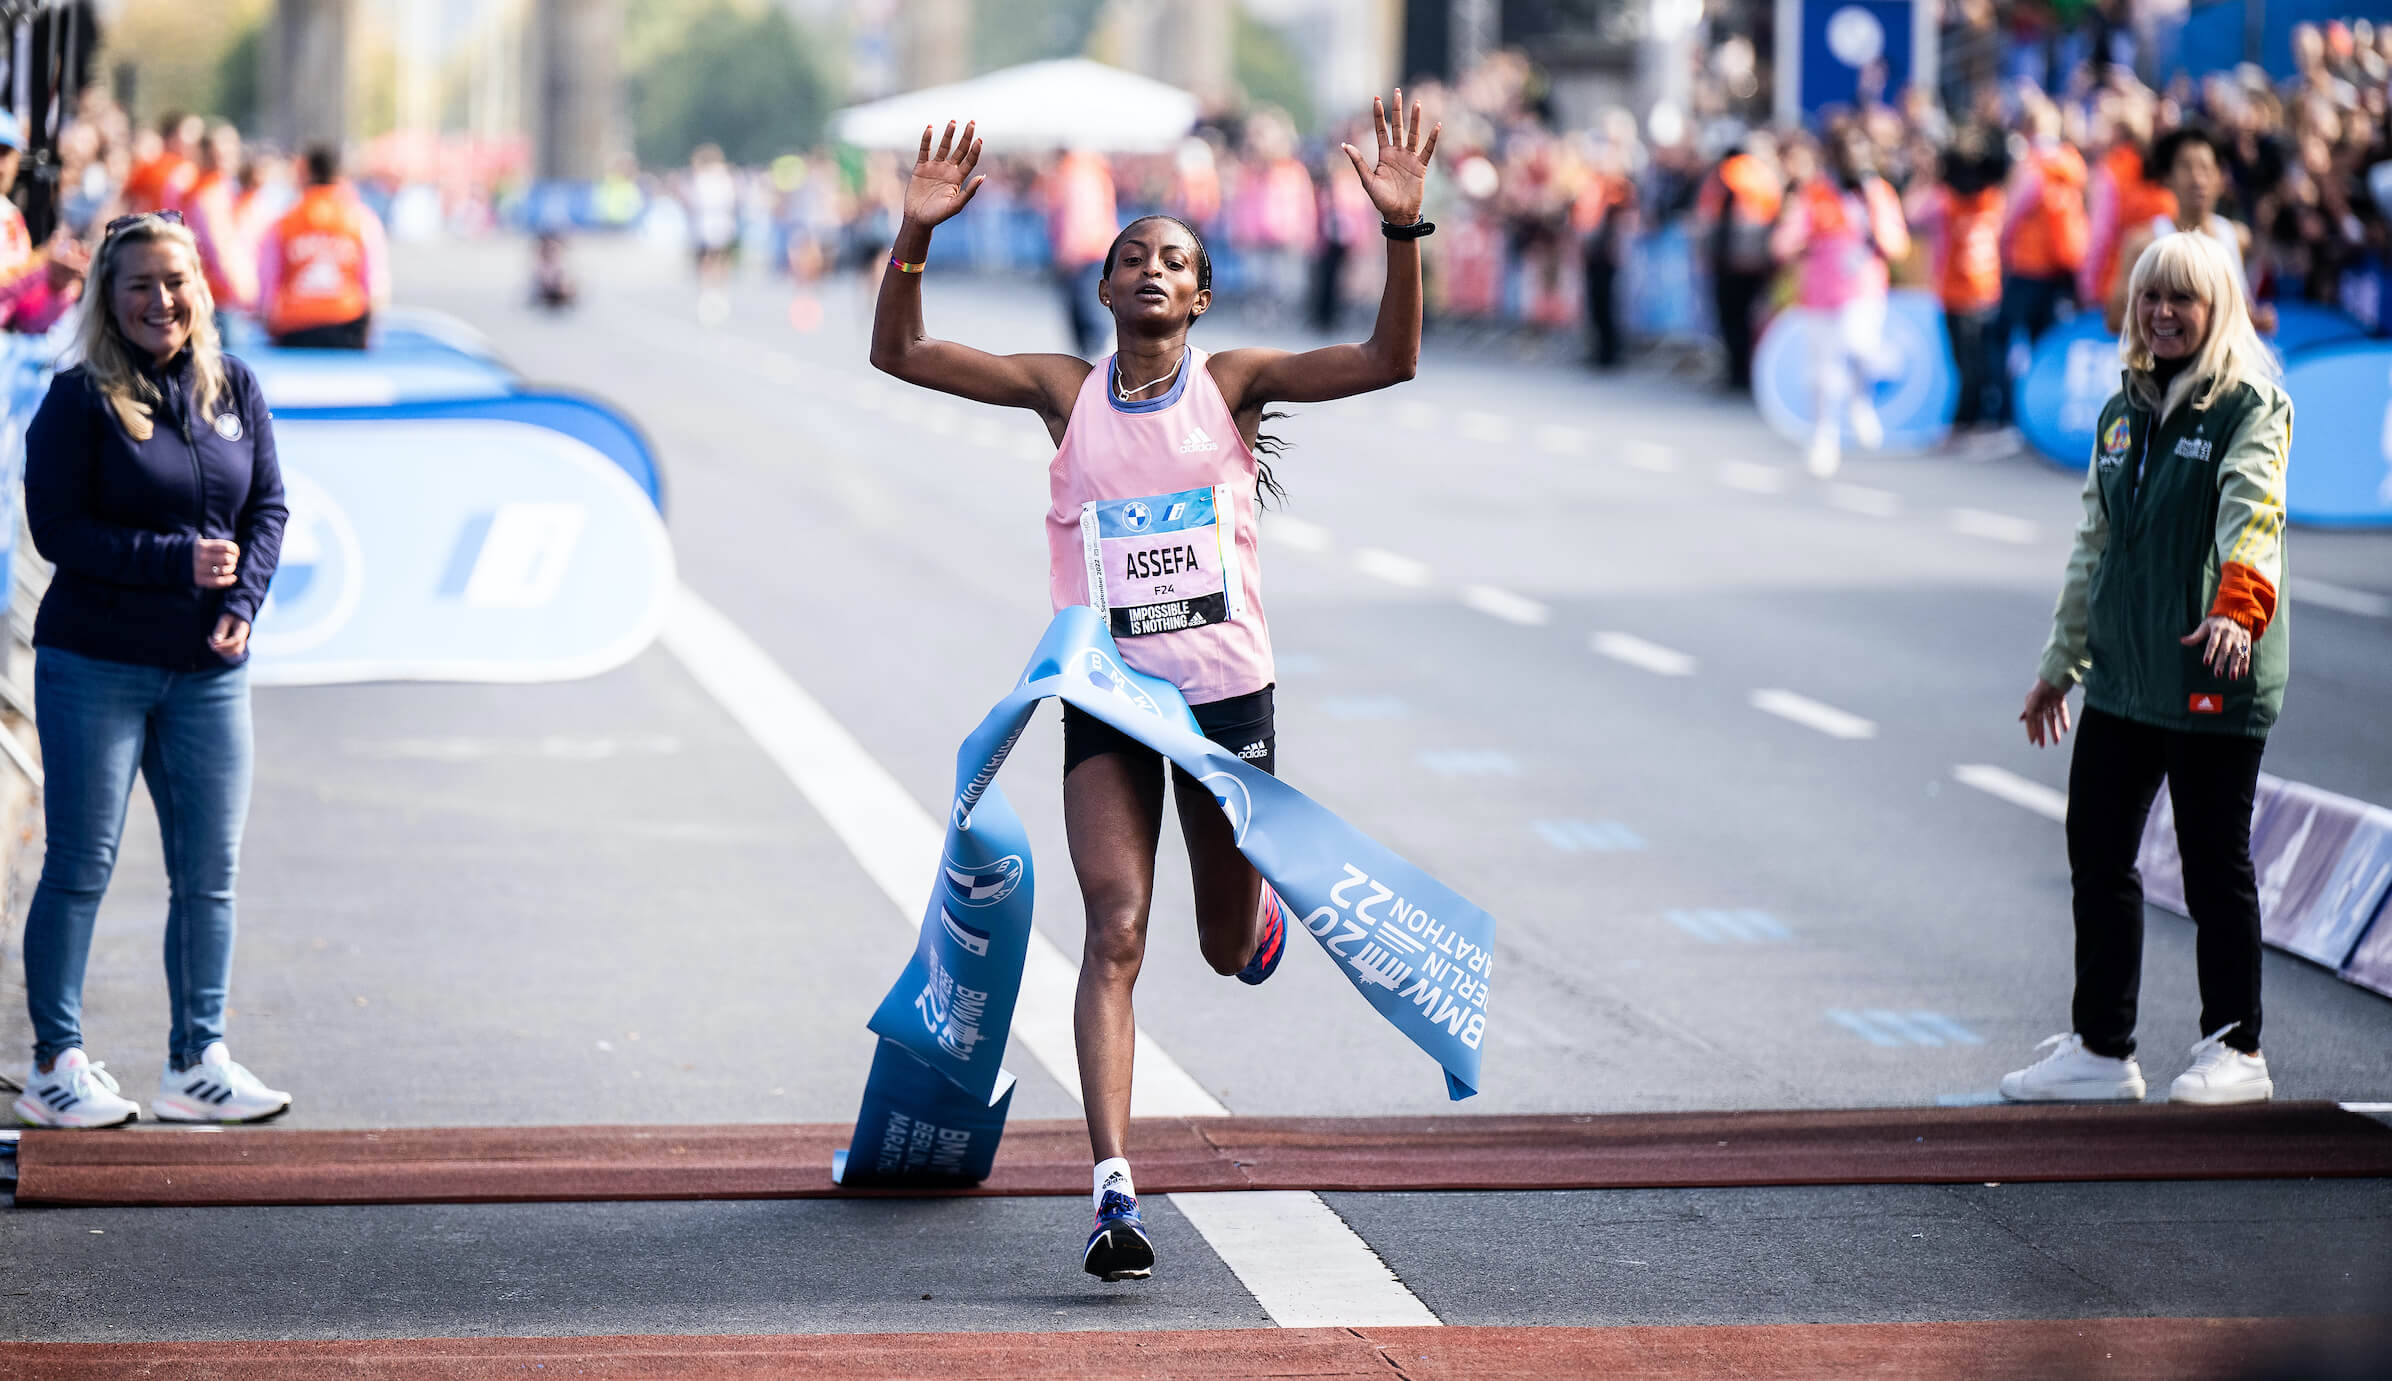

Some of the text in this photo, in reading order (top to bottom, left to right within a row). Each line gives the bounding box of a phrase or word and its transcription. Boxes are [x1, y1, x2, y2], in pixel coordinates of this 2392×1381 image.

[1178, 441, 1219, 454] adidas
[1094, 559, 1103, 576] 2022
[1126, 544, 1199, 580] ASSEFA
[1099, 577, 1107, 613] September
[1154, 584, 1175, 596] F24
[1129, 601, 1190, 622] IMPOSSIBLE
[1131, 614, 1188, 635] IS NOTHING
[1237, 748, 1268, 759] adidas
[1330, 862, 1395, 926] 22
[1301, 905, 1486, 1051] BMW 20
[1420, 951, 1490, 1013] ERLIN
